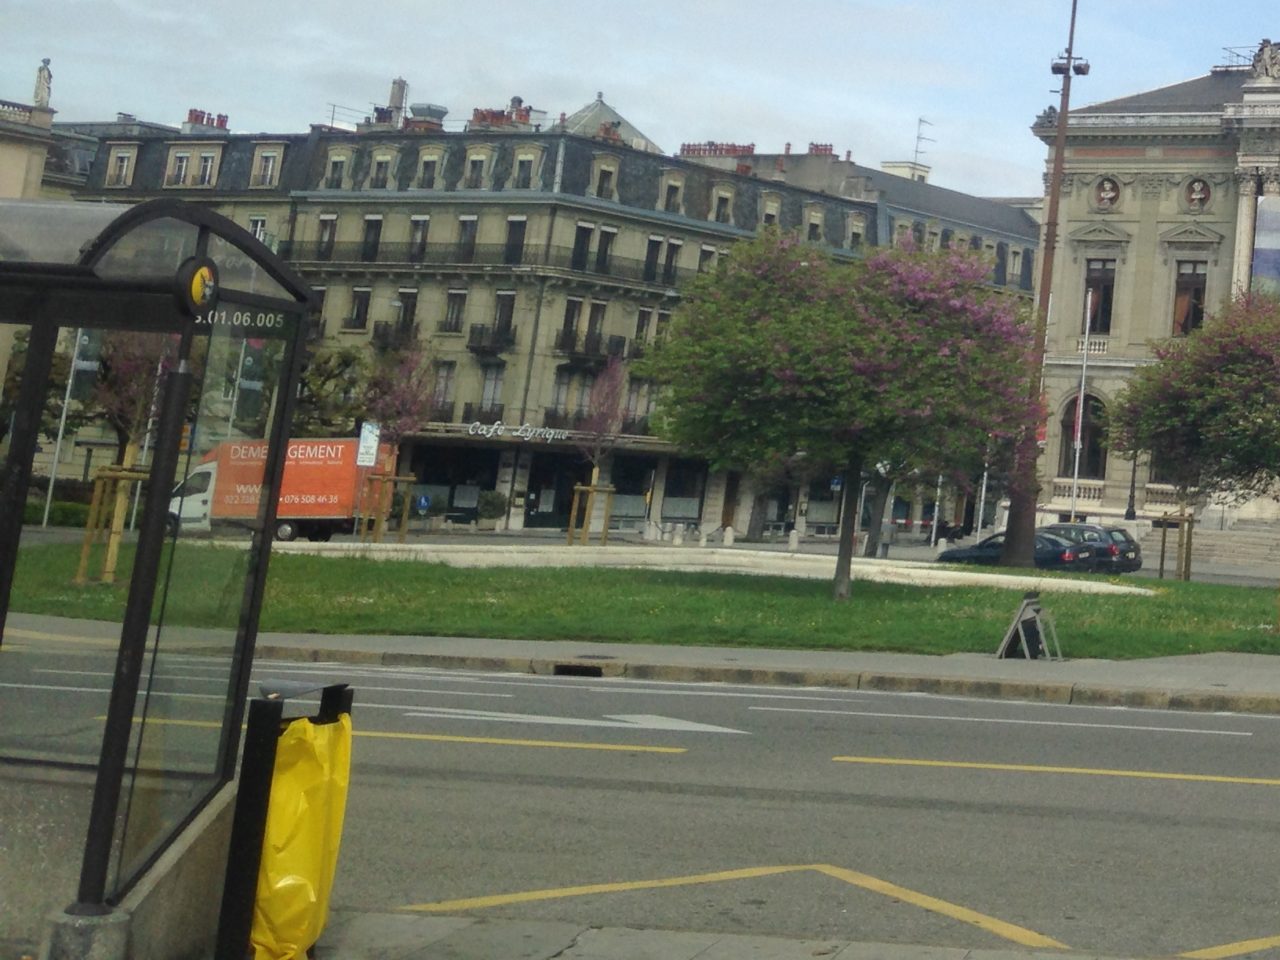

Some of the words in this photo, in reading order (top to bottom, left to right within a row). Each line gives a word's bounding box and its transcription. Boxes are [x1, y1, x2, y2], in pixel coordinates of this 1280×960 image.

[512, 423, 569, 443] Lyrique
[284, 495, 299, 504] 076
[317, 495, 327, 504] 46
